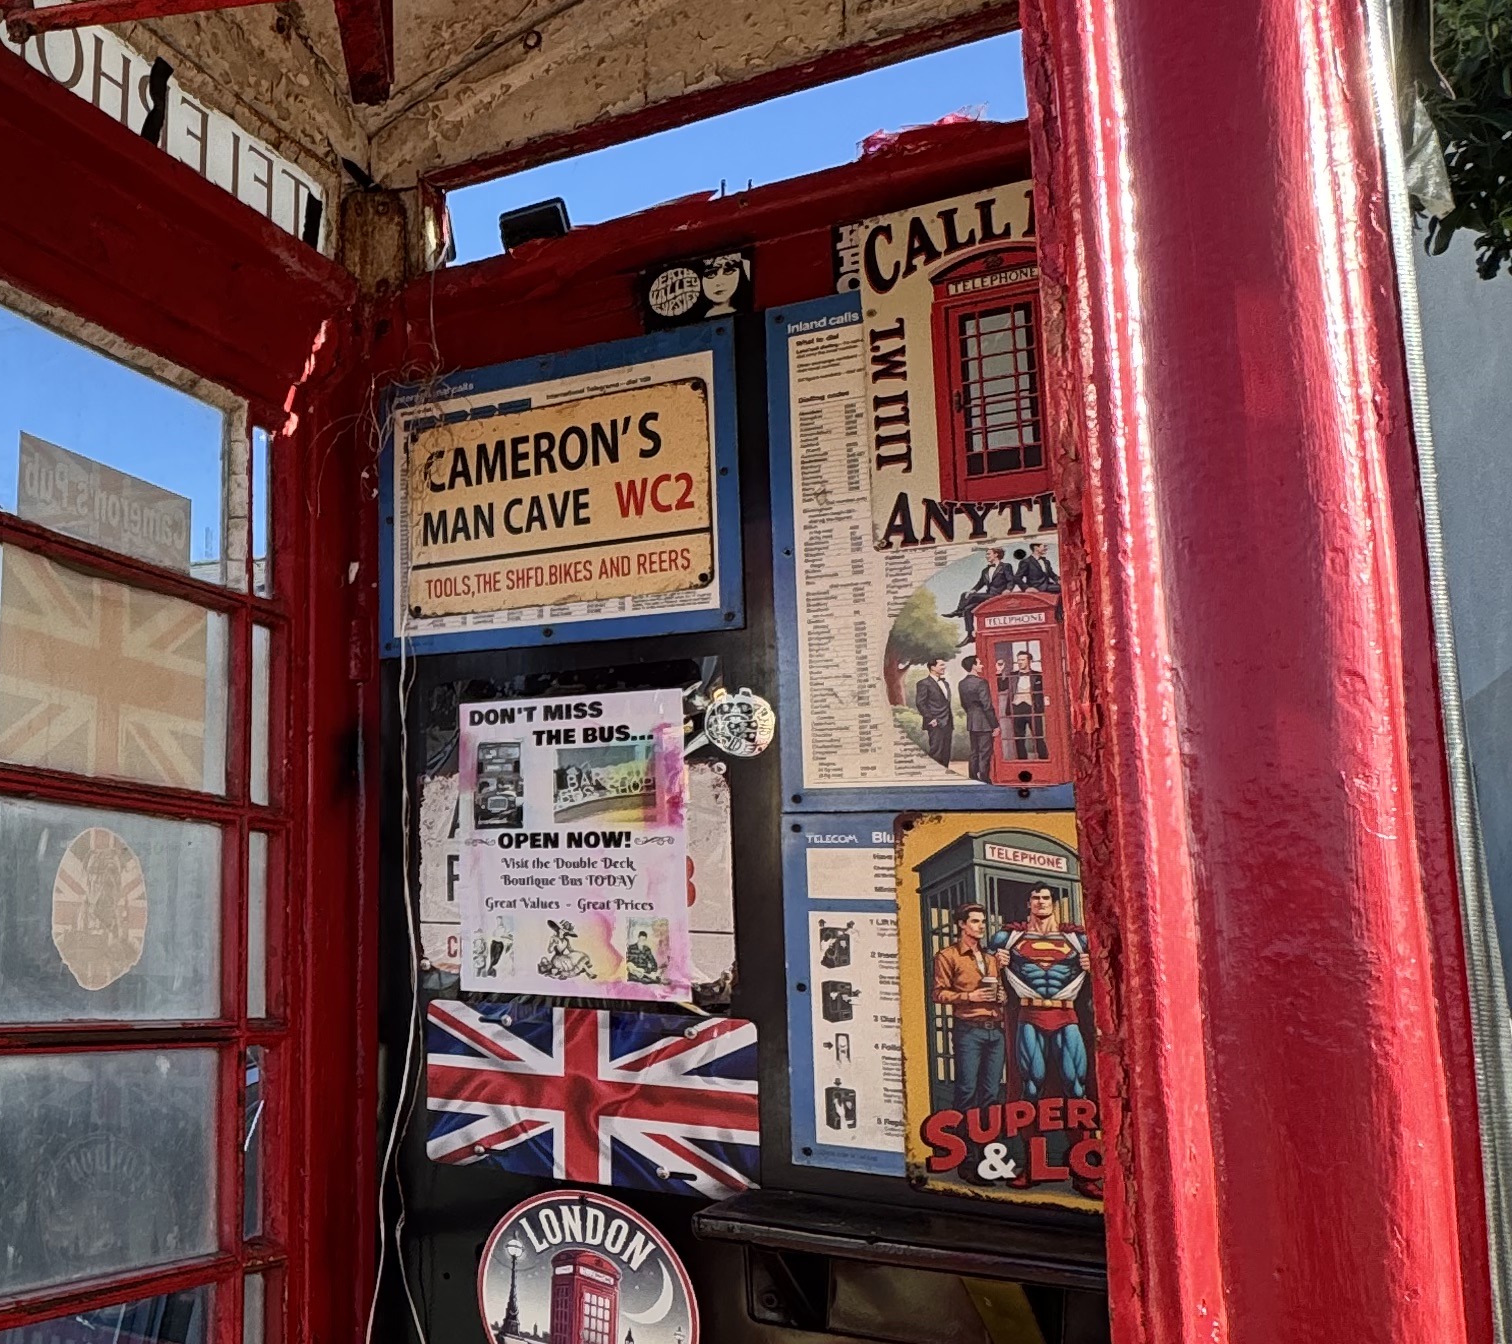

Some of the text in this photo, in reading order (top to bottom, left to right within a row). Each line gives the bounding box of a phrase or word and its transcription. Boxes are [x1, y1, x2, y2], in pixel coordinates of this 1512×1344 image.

[863, 198, 1012, 293] CALL
[952, 266, 1038, 294] TELEPHONE
[788, 317, 827, 333] Inland
[424, 412, 662, 492] CAMERON'S
[423, 472, 695, 546] MAN CAVE WC2
[598, 556, 631, 579] AND
[469, 701, 604, 726] DON'T MISS
[533, 729, 579, 747] THE
[498, 831, 631, 850] OPEN NOW!
[806, 834, 859, 843] TELECOM
[501, 856, 635, 872] Visit the Double Deck
[989, 846, 1064, 869] TELEPHONE
[501, 872, 638, 891] Boutique Bus TODAY
[485, 897, 517, 911] Great
[520, 897, 561, 911] Values
[577, 897, 611, 913] Great
[613, 899, 654, 912] Prices
[977, 1142, 1016, 1180] &
[519, 1204, 657, 1272] LONDON
